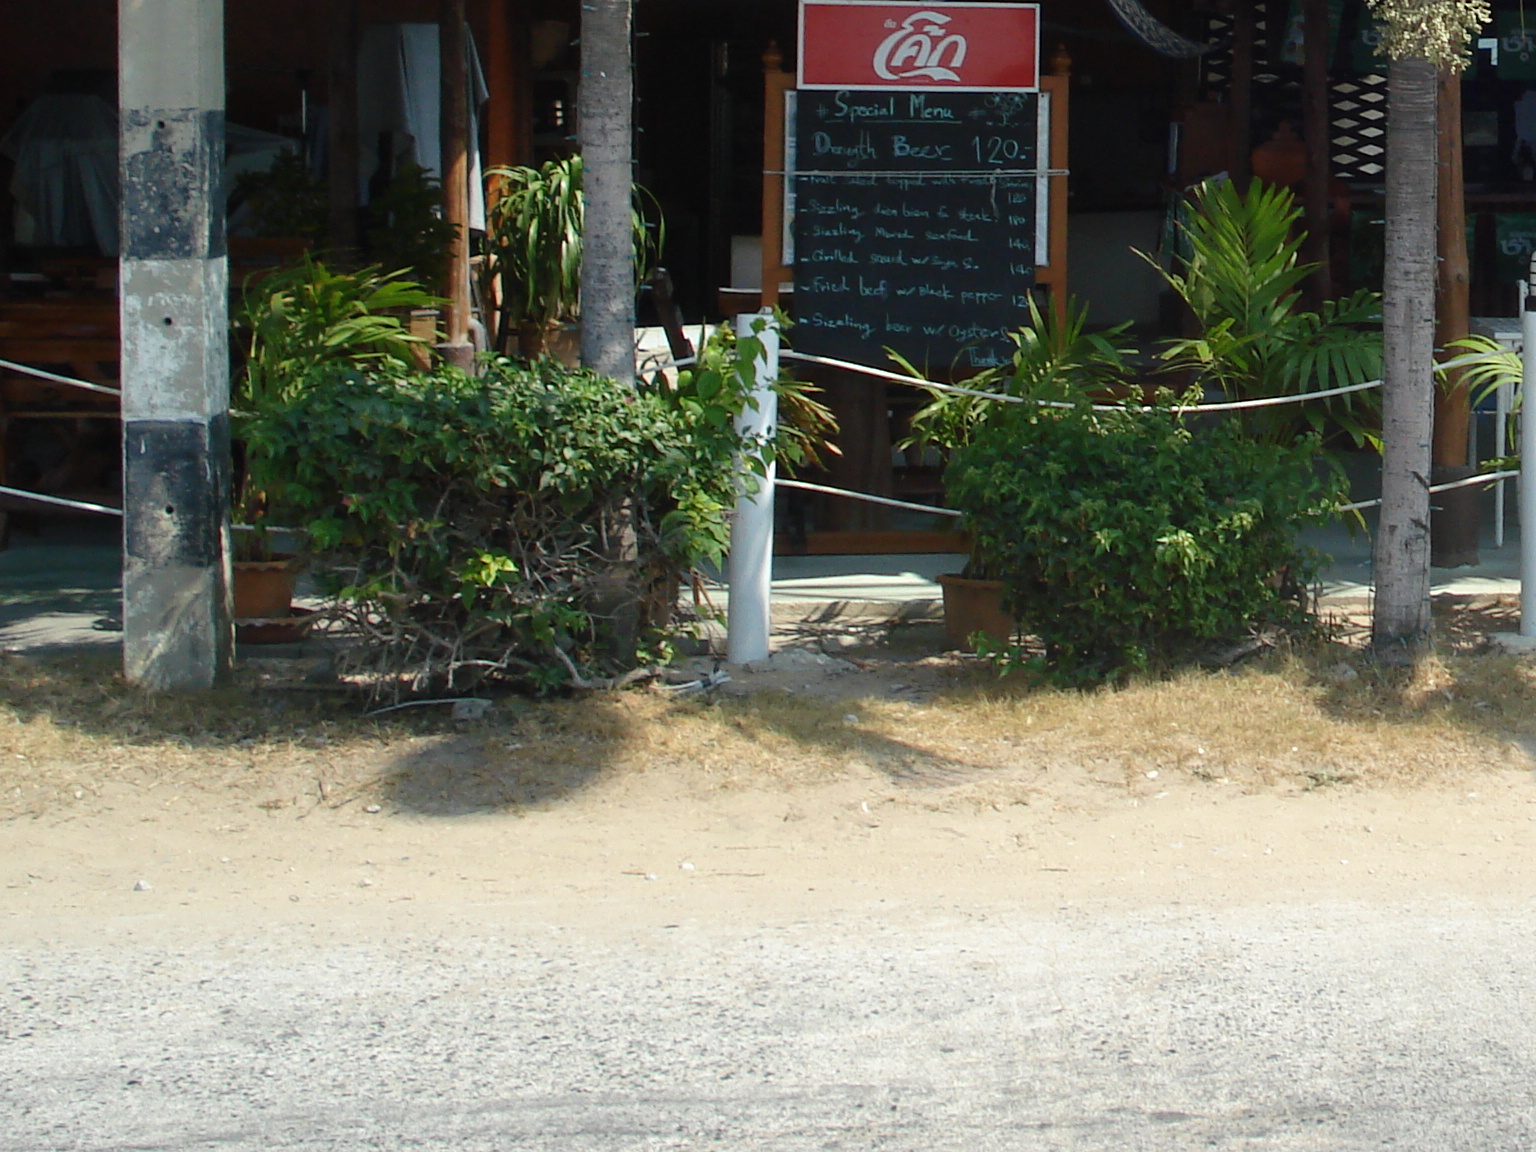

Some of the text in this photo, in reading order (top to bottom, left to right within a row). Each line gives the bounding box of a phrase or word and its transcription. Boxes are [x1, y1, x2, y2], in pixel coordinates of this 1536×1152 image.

[834, 90, 955, 123] Special Menu
[892, 134, 953, 161] Beer
